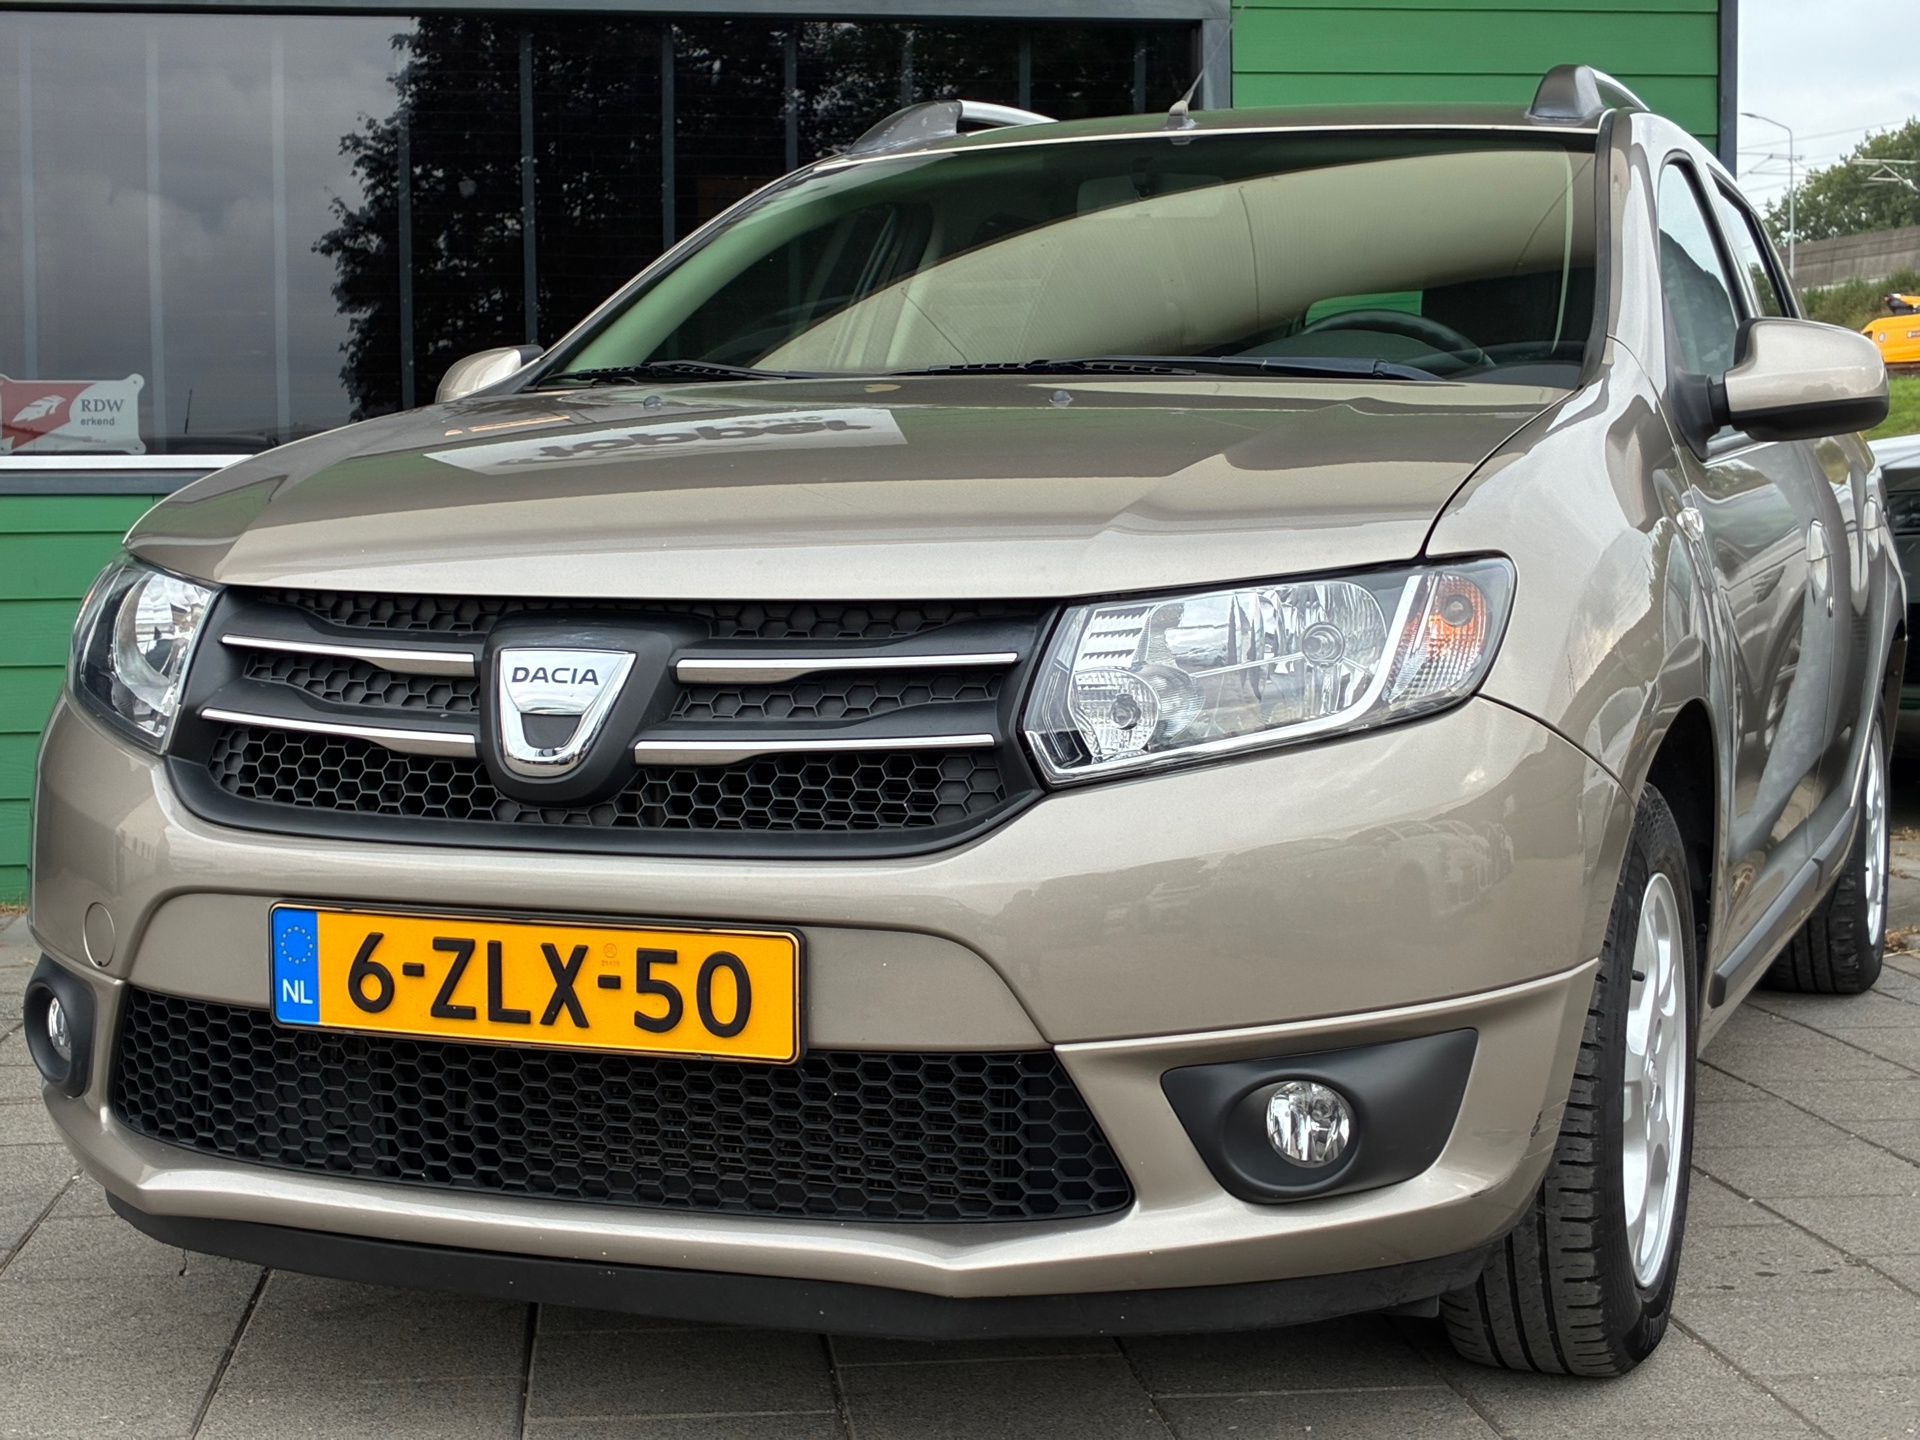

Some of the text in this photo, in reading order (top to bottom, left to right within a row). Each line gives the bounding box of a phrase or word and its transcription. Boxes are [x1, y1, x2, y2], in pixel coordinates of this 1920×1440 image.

[81, 399, 125, 413] RDW
[80, 417, 115, 426] erkend
[511, 667, 599, 686] DACIA
[282, 979, 314, 1005] NL
[347, 931, 752, 1039] 6-ZLX-50
